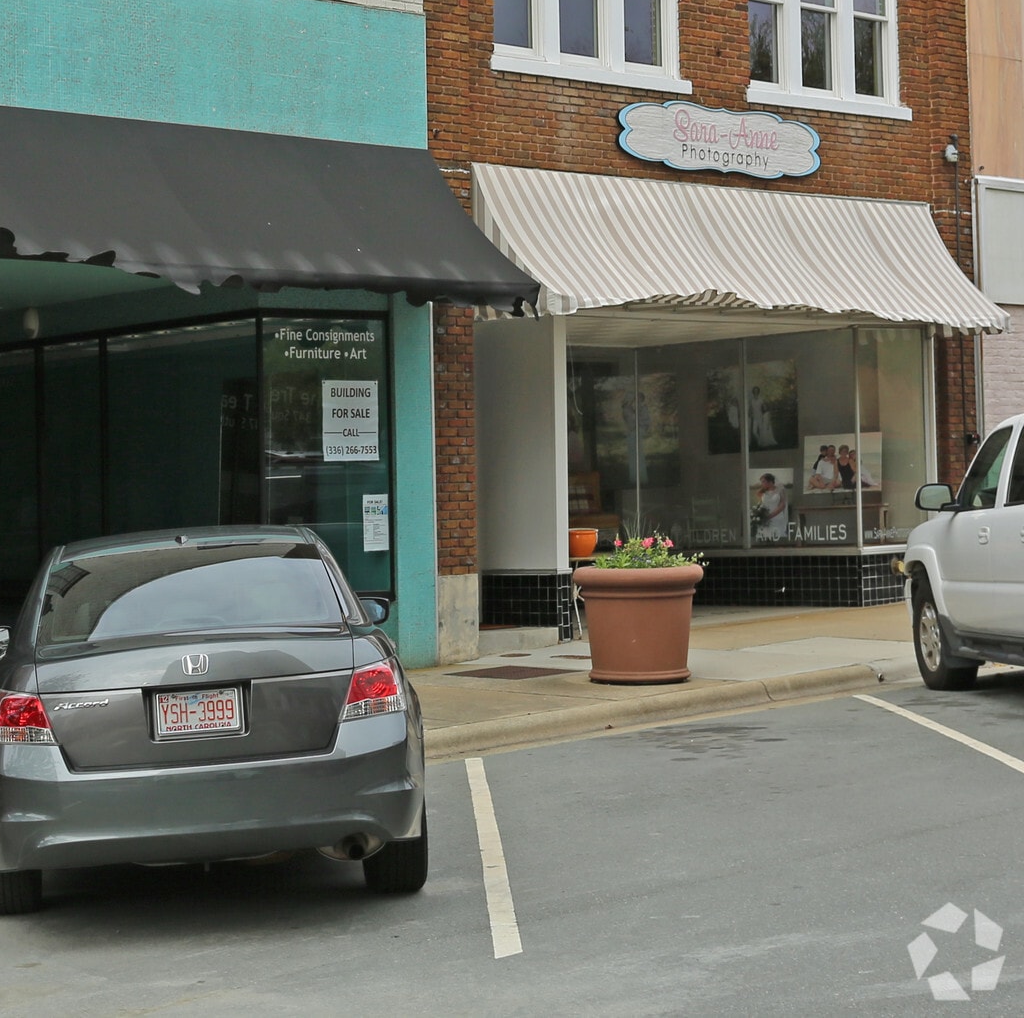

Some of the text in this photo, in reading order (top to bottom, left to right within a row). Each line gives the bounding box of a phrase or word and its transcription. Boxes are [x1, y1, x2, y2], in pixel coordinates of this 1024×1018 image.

[673, 109, 780, 151] Sara-Anne
[681, 143, 769, 171] Photography
[279, 328, 375, 344] Fine Consignments
[289, 346, 368, 360] Furniture Art
[330, 387, 372, 398] BUILDING
[331, 408, 371, 419] FOR SALE
[342, 428, 360, 437] CALL
[788, 522, 848, 542] FAMILIES
[53, 698, 109, 711] Accord
[161, 699, 235, 724] YSH-3999
